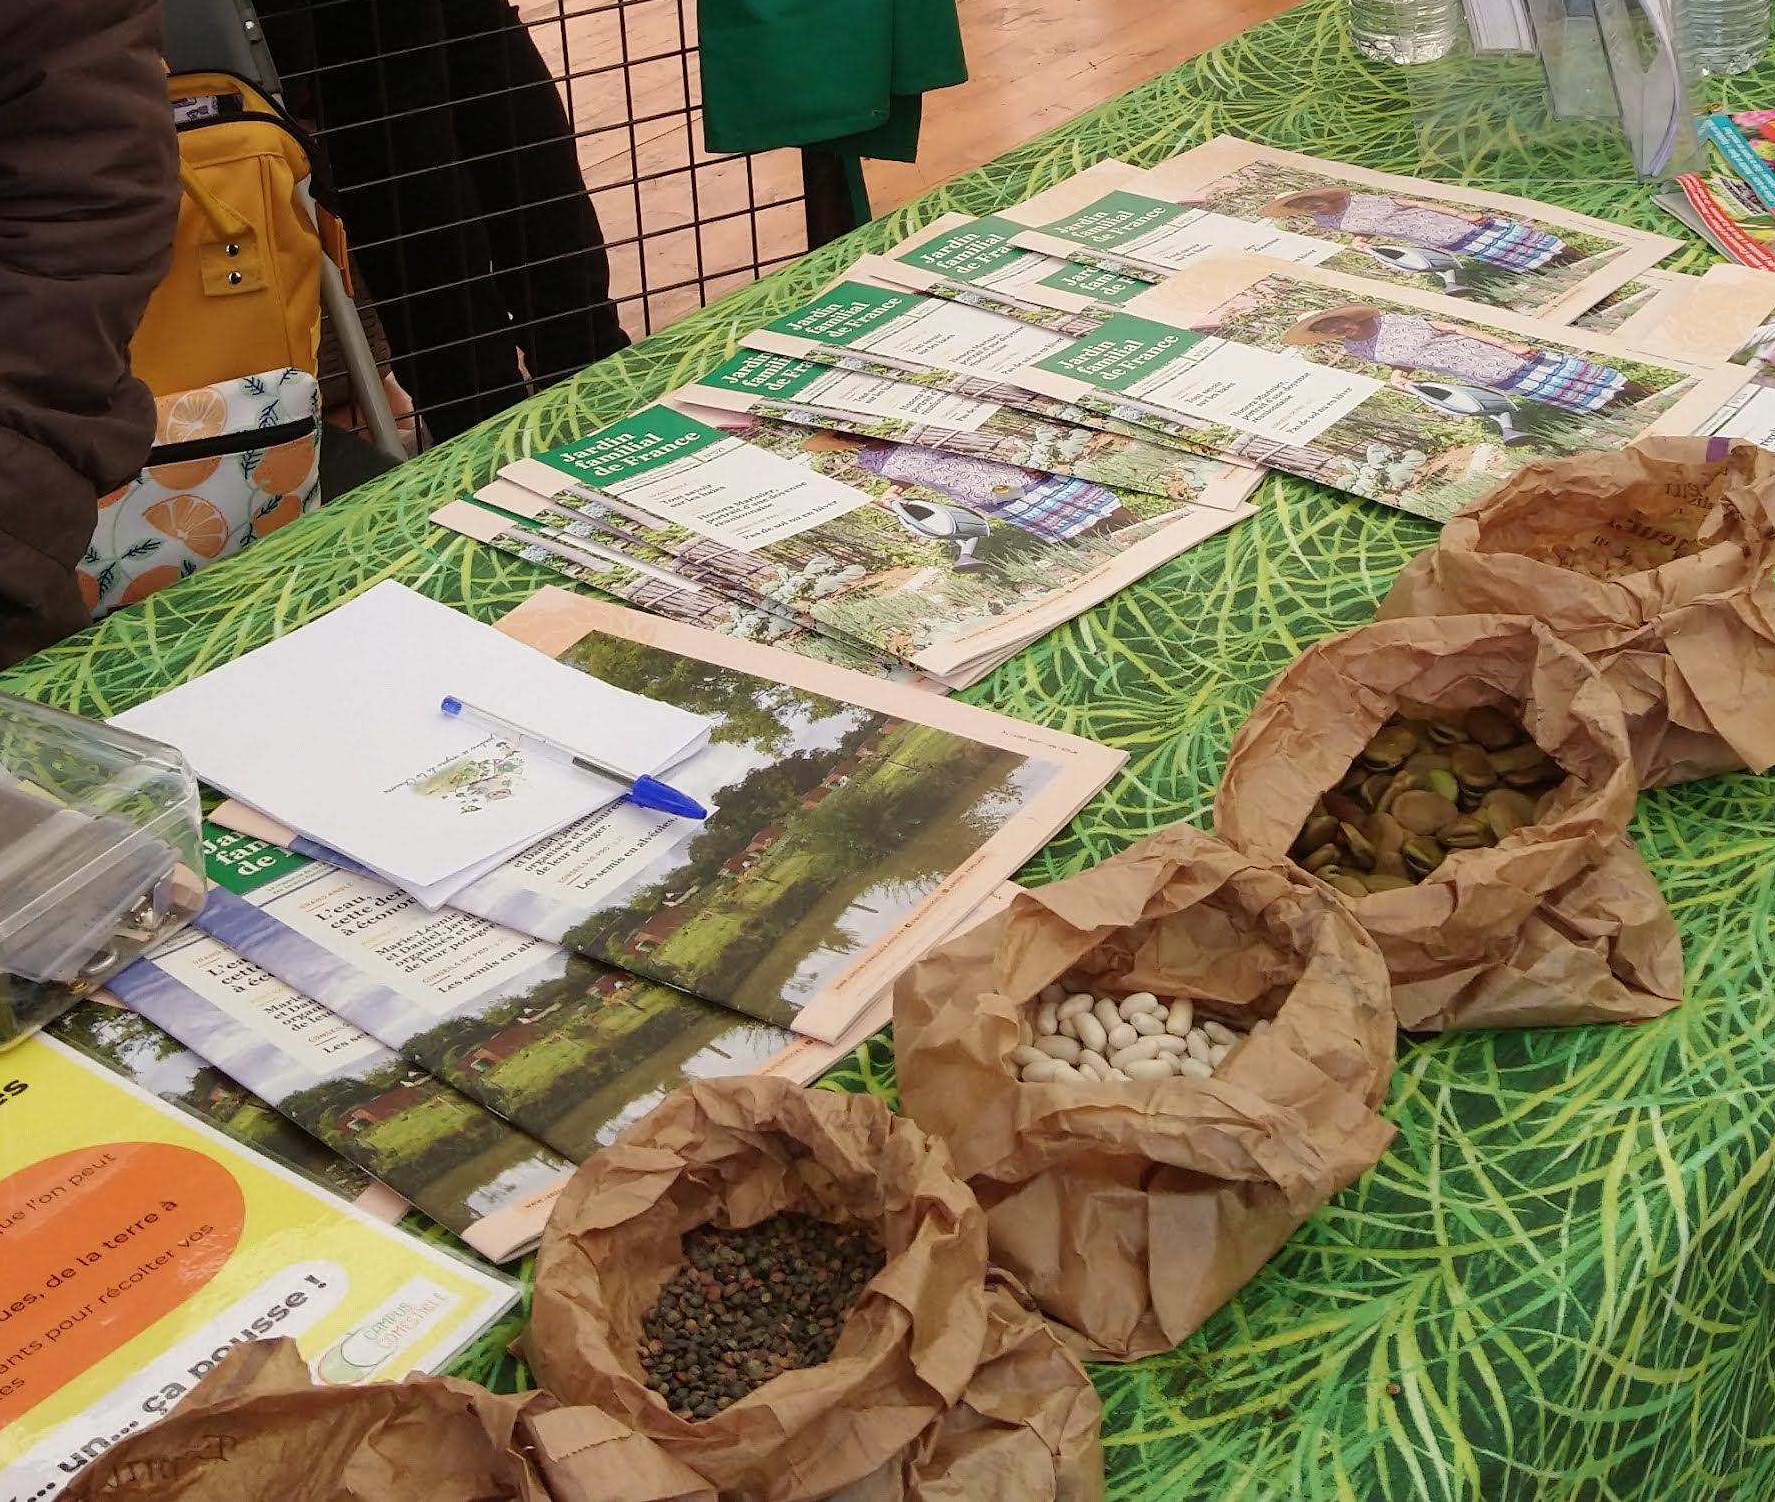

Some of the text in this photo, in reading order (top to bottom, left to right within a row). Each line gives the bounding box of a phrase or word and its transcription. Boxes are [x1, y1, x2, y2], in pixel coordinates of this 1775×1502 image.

[1057, 339, 1116, 370] Jardin
[1078, 339, 1145, 375] familial
[1100, 334, 1179, 381] de France
[560, 432, 635, 462] Jardin
[575, 433, 664, 470] familial
[594, 430, 701, 477] de France
[573, 823, 612, 853] potager.
[576, 816, 678, 890] Les semis en alvéoles.
[315, 895, 373, 921] L'eau,
[331, 905, 374, 929] cette
[25, 1185, 66, 1211] l'on
[68, 1153, 117, 1187] peut
[45, 1266, 77, 1289] de
[77, 1249, 102, 1268] la
[103, 1213, 158, 1250] terre
[160, 1200, 178, 1215] à
[45, 1306, 95, 1343] pour
[98, 1250, 175, 1306] récolter
[177, 1224, 213, 1248] vos
[363, 1301, 411, 1339] CAMPUS
[142, 1381, 188, 1416] ça
[188, 1287, 308, 1382] pousse
